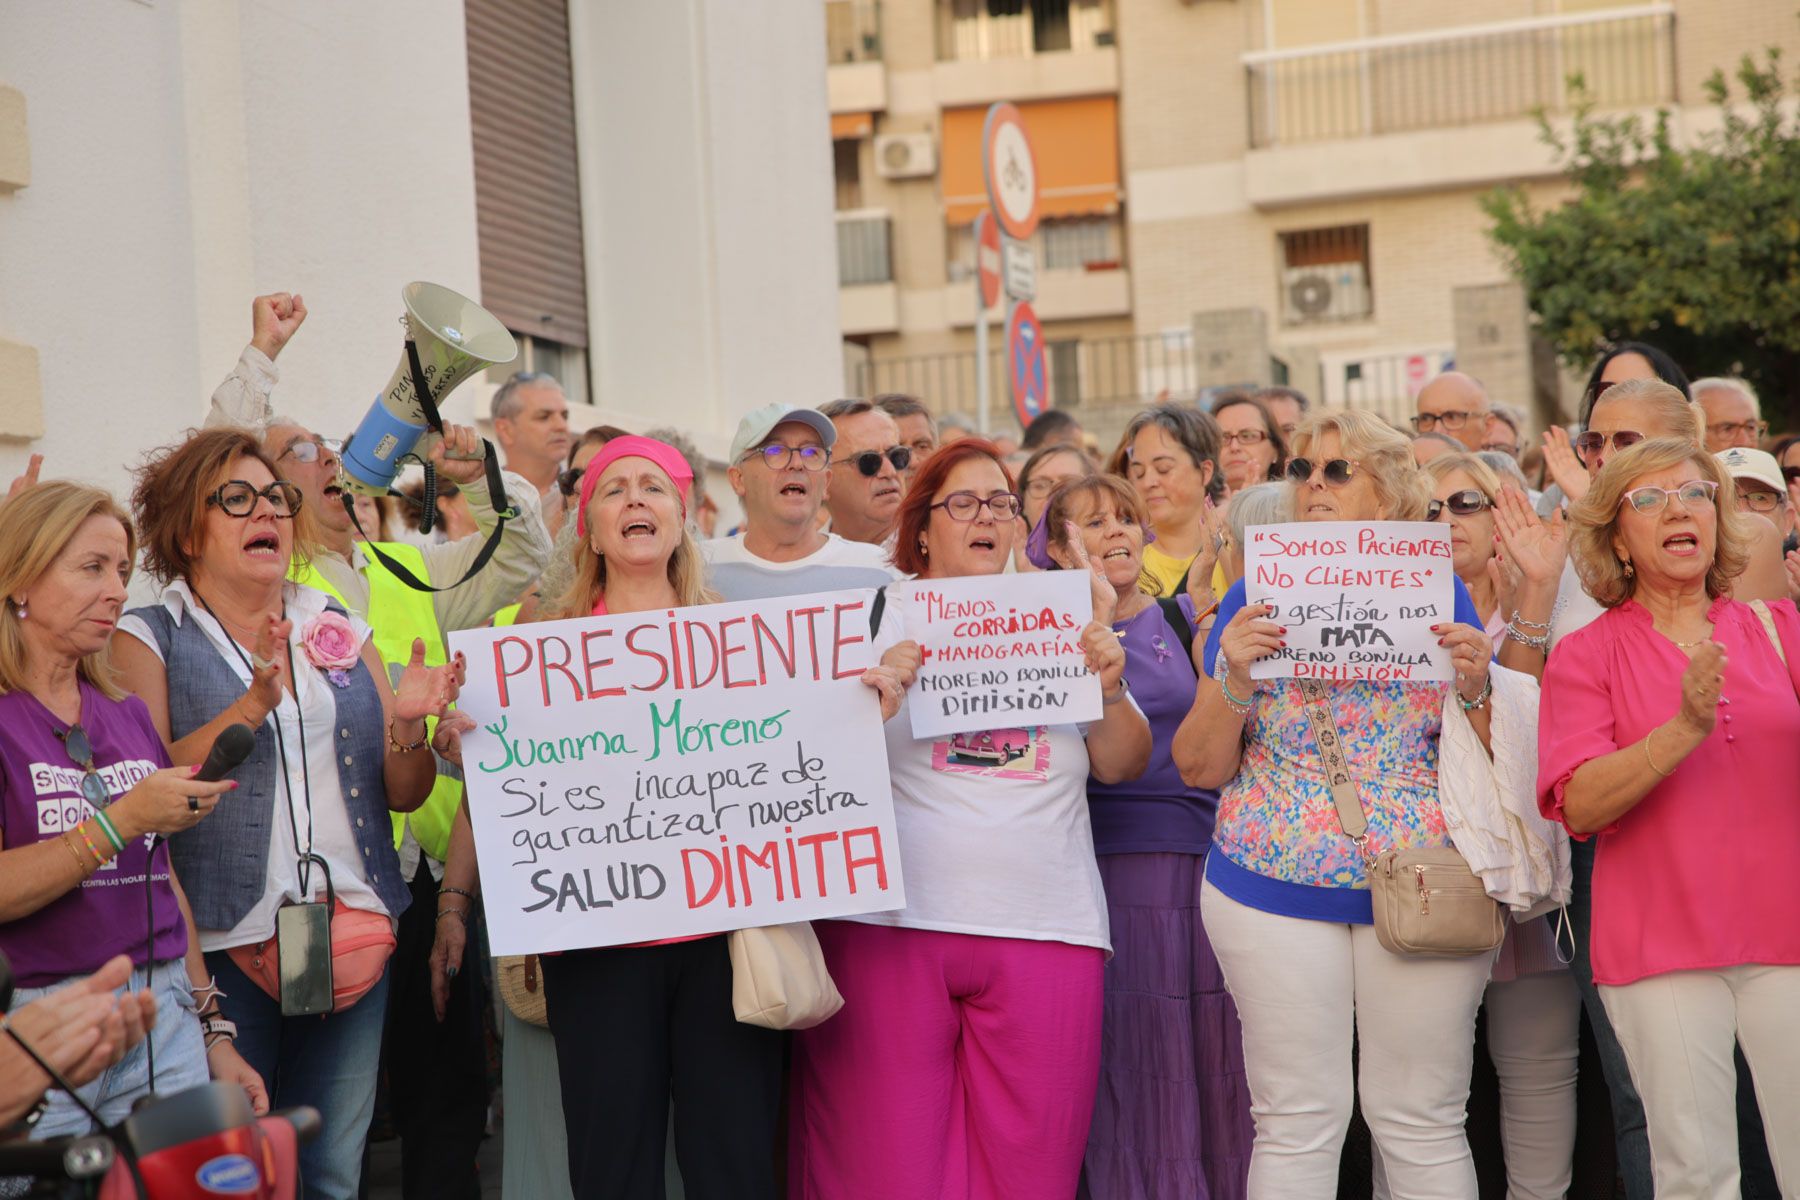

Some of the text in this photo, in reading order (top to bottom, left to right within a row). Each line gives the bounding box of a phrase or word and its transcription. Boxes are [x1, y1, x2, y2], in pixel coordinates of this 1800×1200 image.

[1358, 528, 1452, 558] PACIENTES
[1256, 562, 1295, 588] NO
[1283, 593, 1388, 627] gestión
[1399, 603, 1439, 620] nos
[1320, 623, 1395, 648] MATA
[492, 601, 868, 708] PRESIDENTE
[1348, 648, 1433, 667] BONILLA
[920, 670, 1009, 692] MORENO
[1293, 662, 1413, 680] DIMISIÓN
[941, 684, 1069, 717] DIMISIÓN
[478, 698, 791, 773] Juanma Moreno
[500, 740, 827, 818] Si es incapaz de
[511, 782, 868, 867] garantizar nuestra
[81, 878, 106, 888] CONTRA
[106, 877, 119, 887] LAS
[521, 825, 889, 913] SALUD DIMITA
